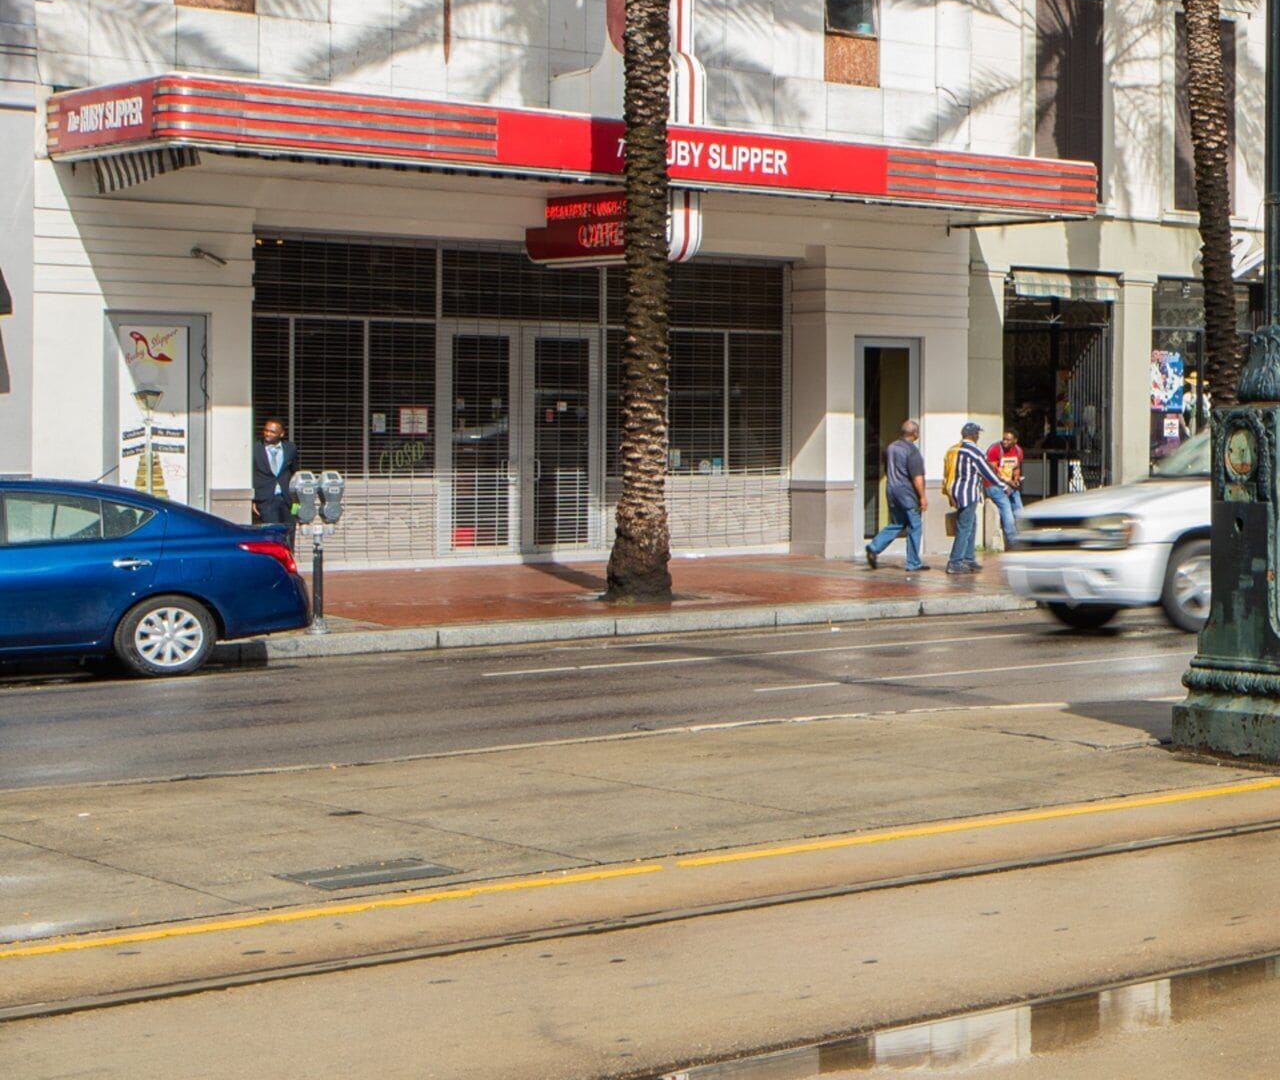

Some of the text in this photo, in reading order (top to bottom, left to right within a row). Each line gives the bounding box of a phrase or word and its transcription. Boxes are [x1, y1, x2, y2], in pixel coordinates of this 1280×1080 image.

[105, 96, 143, 129] SLIPPER
[666, 138, 788, 176] UBY SLIPPER
